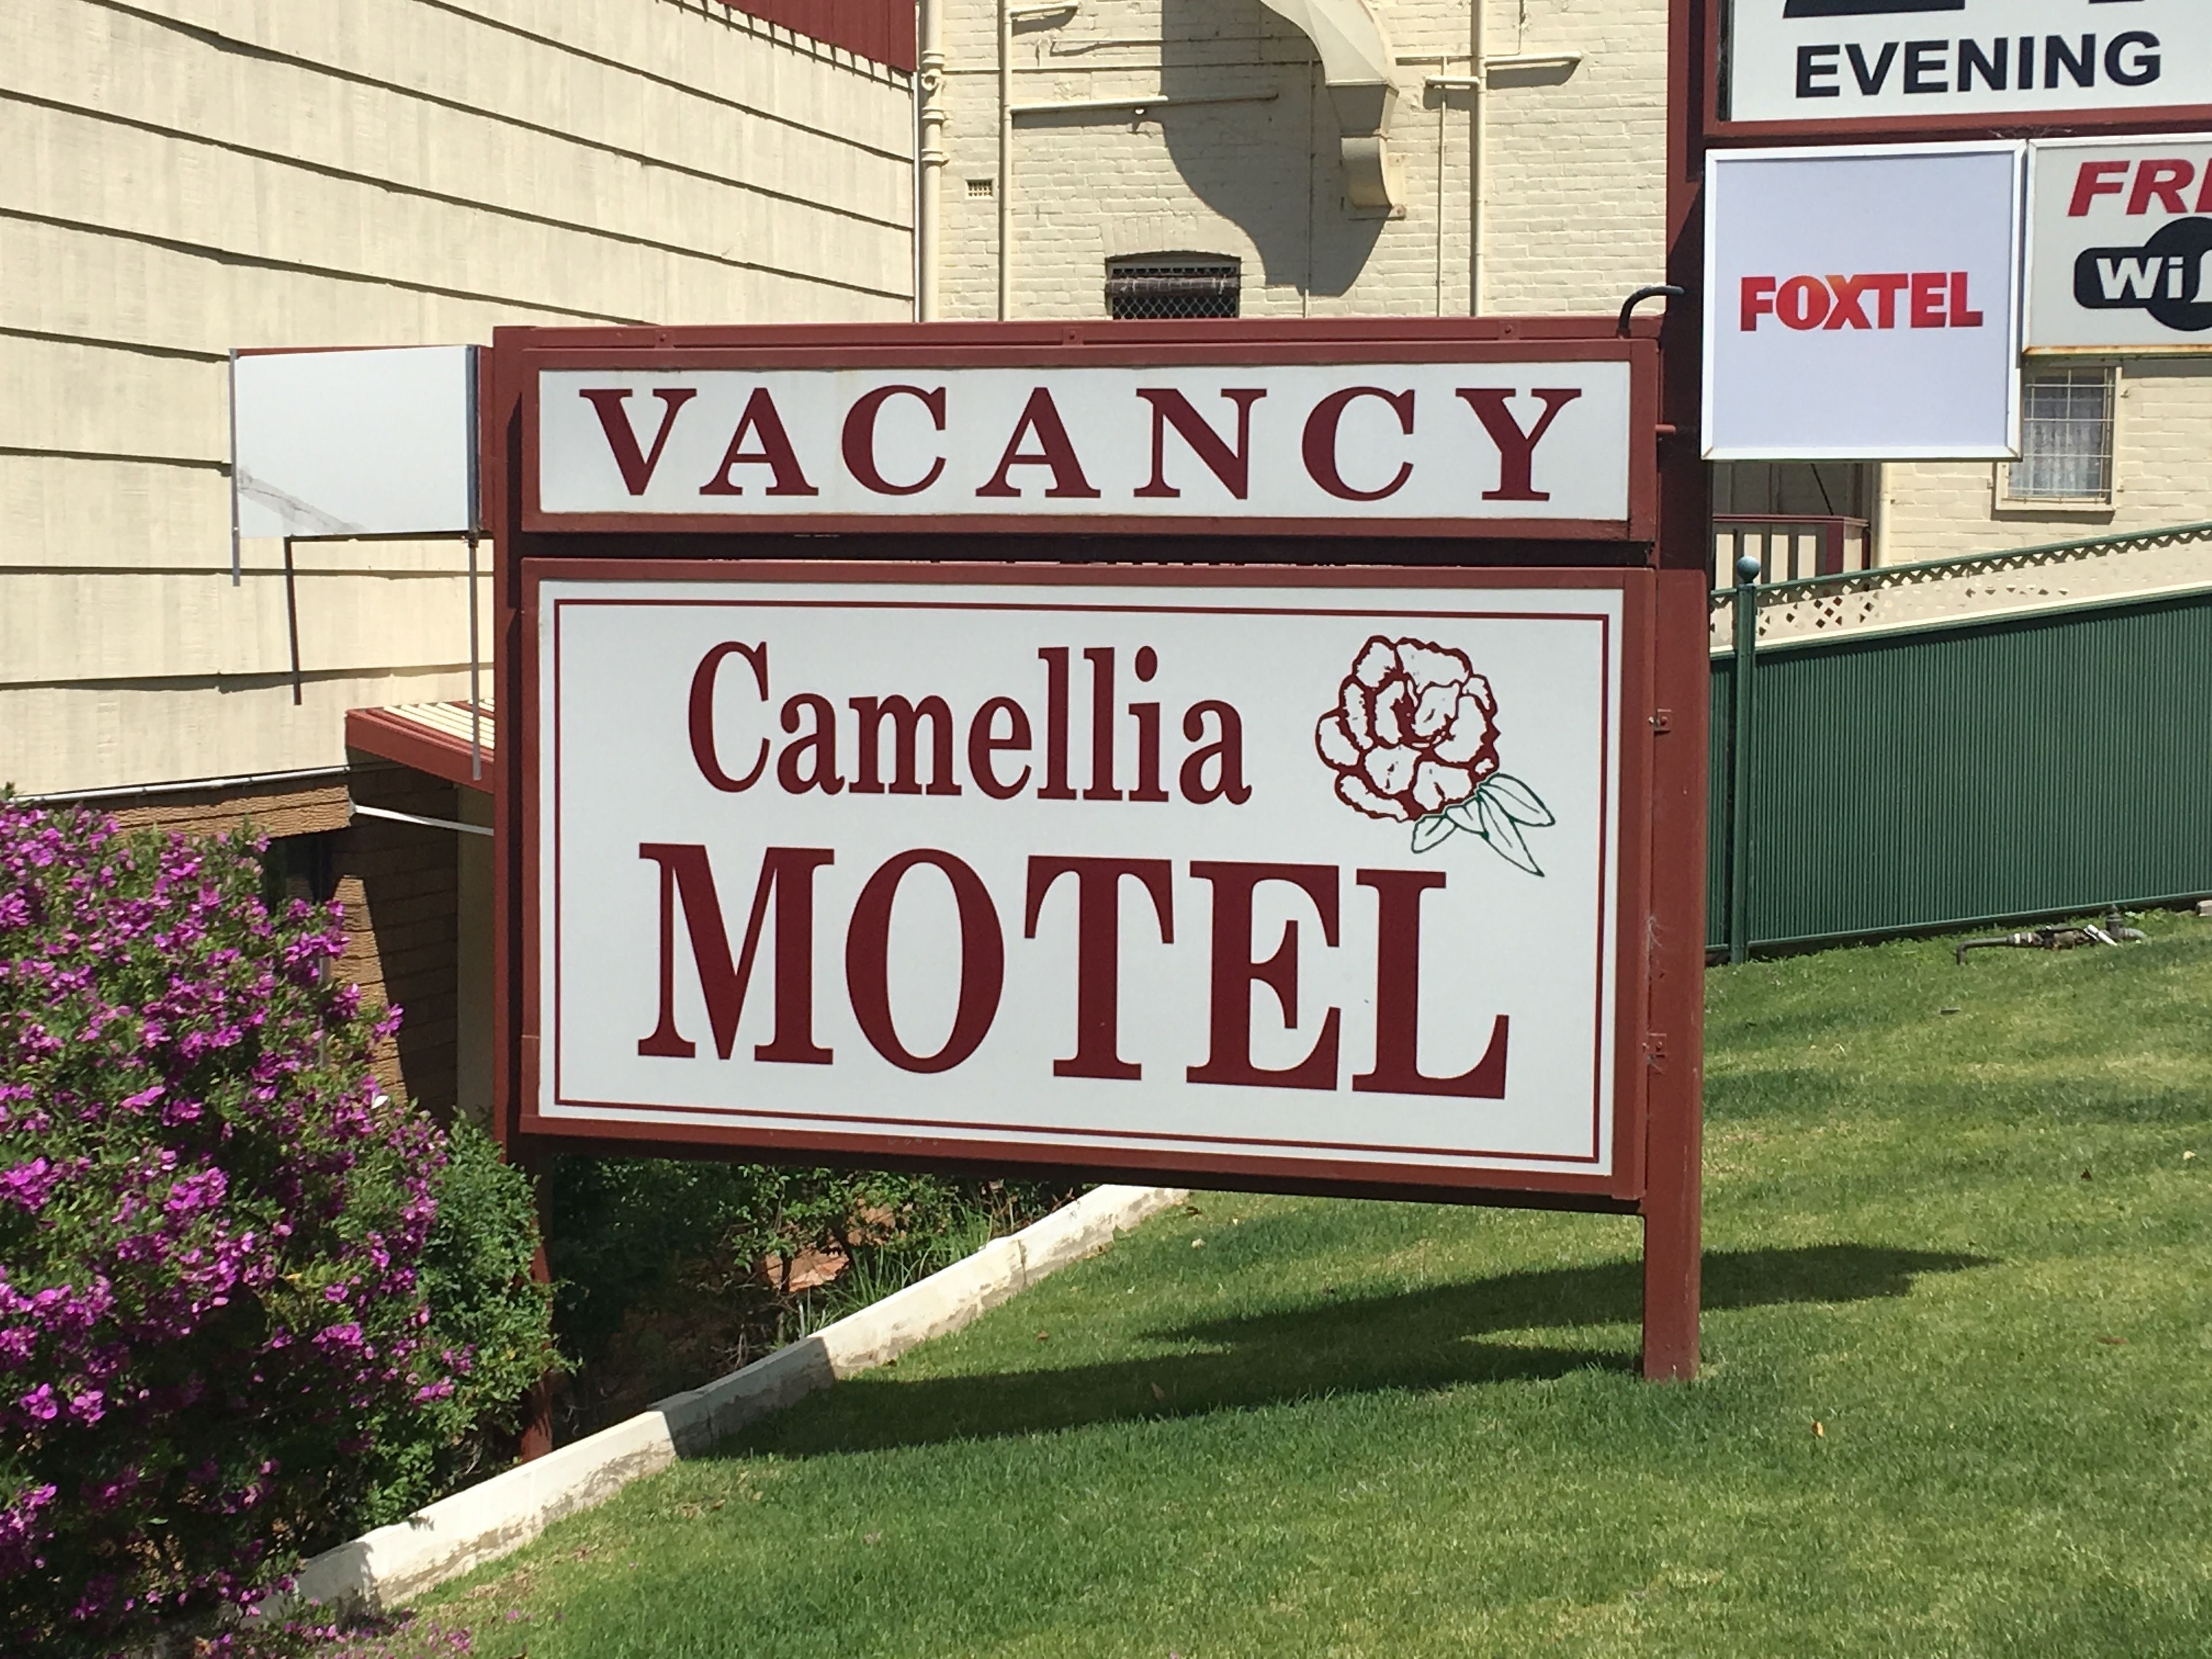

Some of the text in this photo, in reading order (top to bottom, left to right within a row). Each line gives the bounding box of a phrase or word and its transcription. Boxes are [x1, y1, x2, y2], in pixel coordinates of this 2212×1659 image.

[1796, 31, 2161, 99] EVENING
[1740, 271, 1984, 332] FOXTEL
[578, 384, 1582, 502] VACANCY
[688, 641, 1252, 805] Camellia
[637, 842, 1510, 1100] MOTEL
